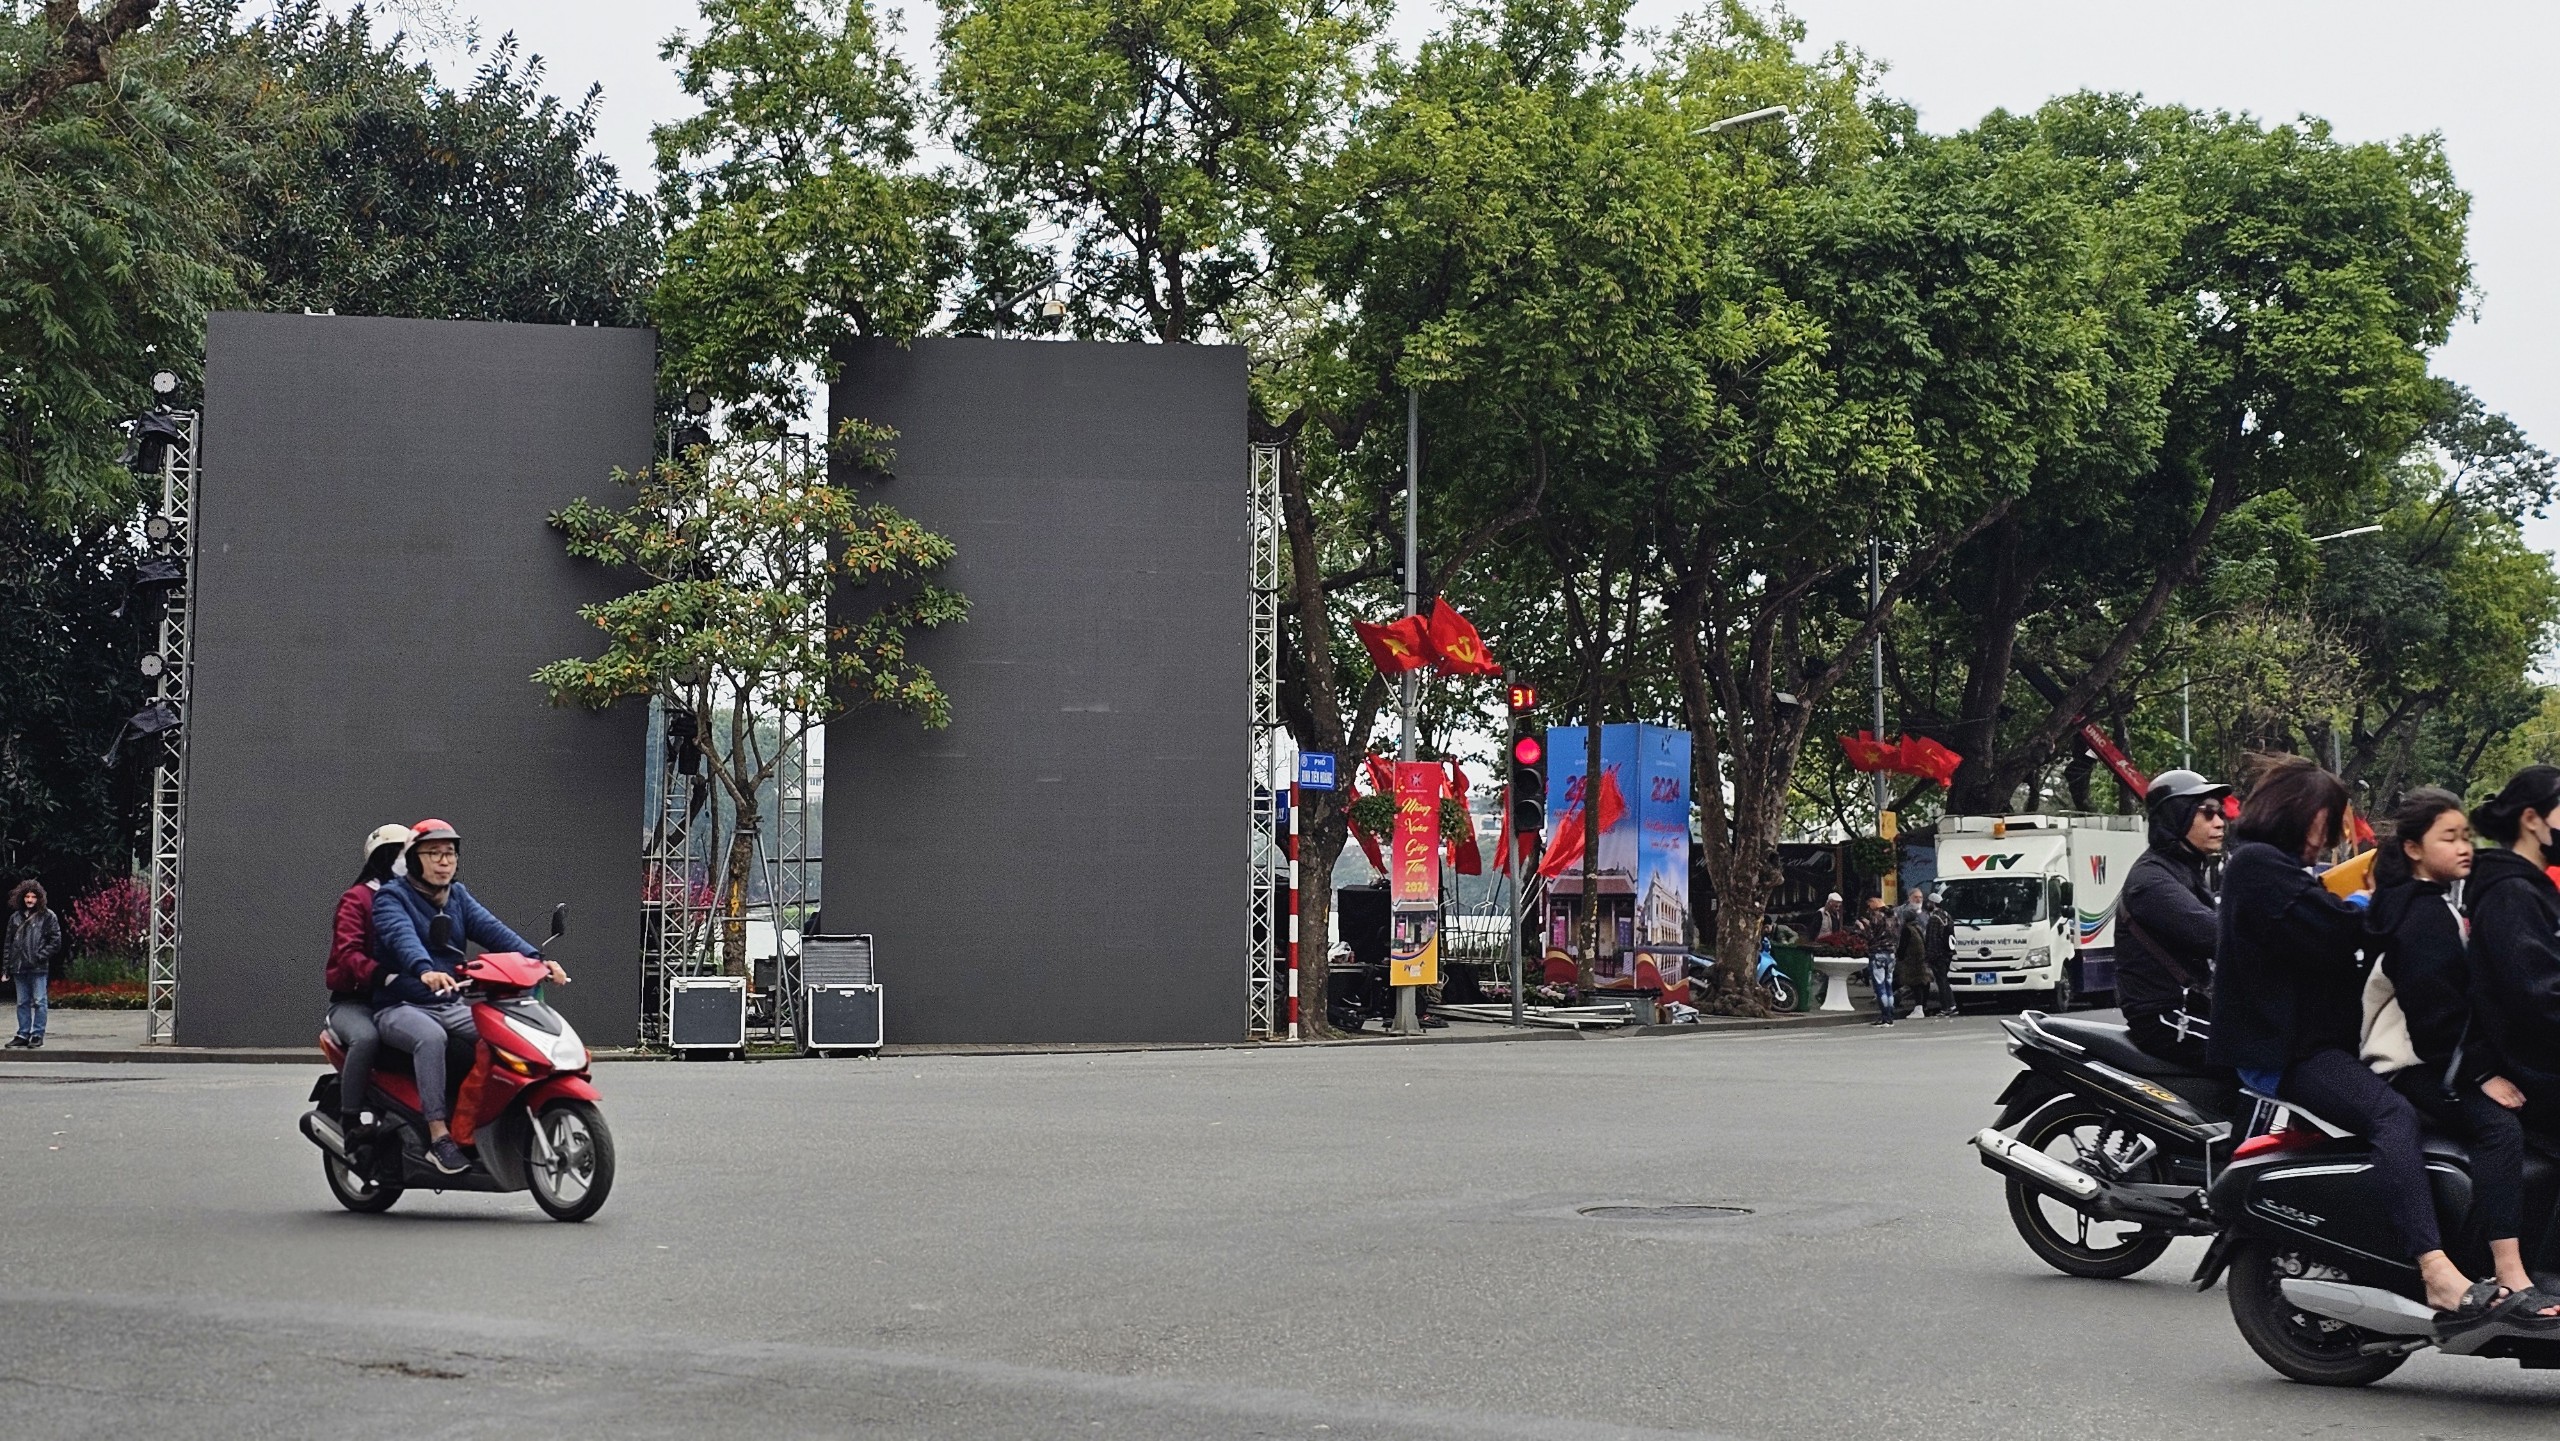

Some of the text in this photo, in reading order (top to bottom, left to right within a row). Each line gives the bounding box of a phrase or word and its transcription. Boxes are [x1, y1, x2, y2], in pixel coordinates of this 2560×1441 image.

[1513, 689, 1533, 707] 31
[1961, 853, 2025, 871] VTV
[1405, 881, 1429, 893] 2024
